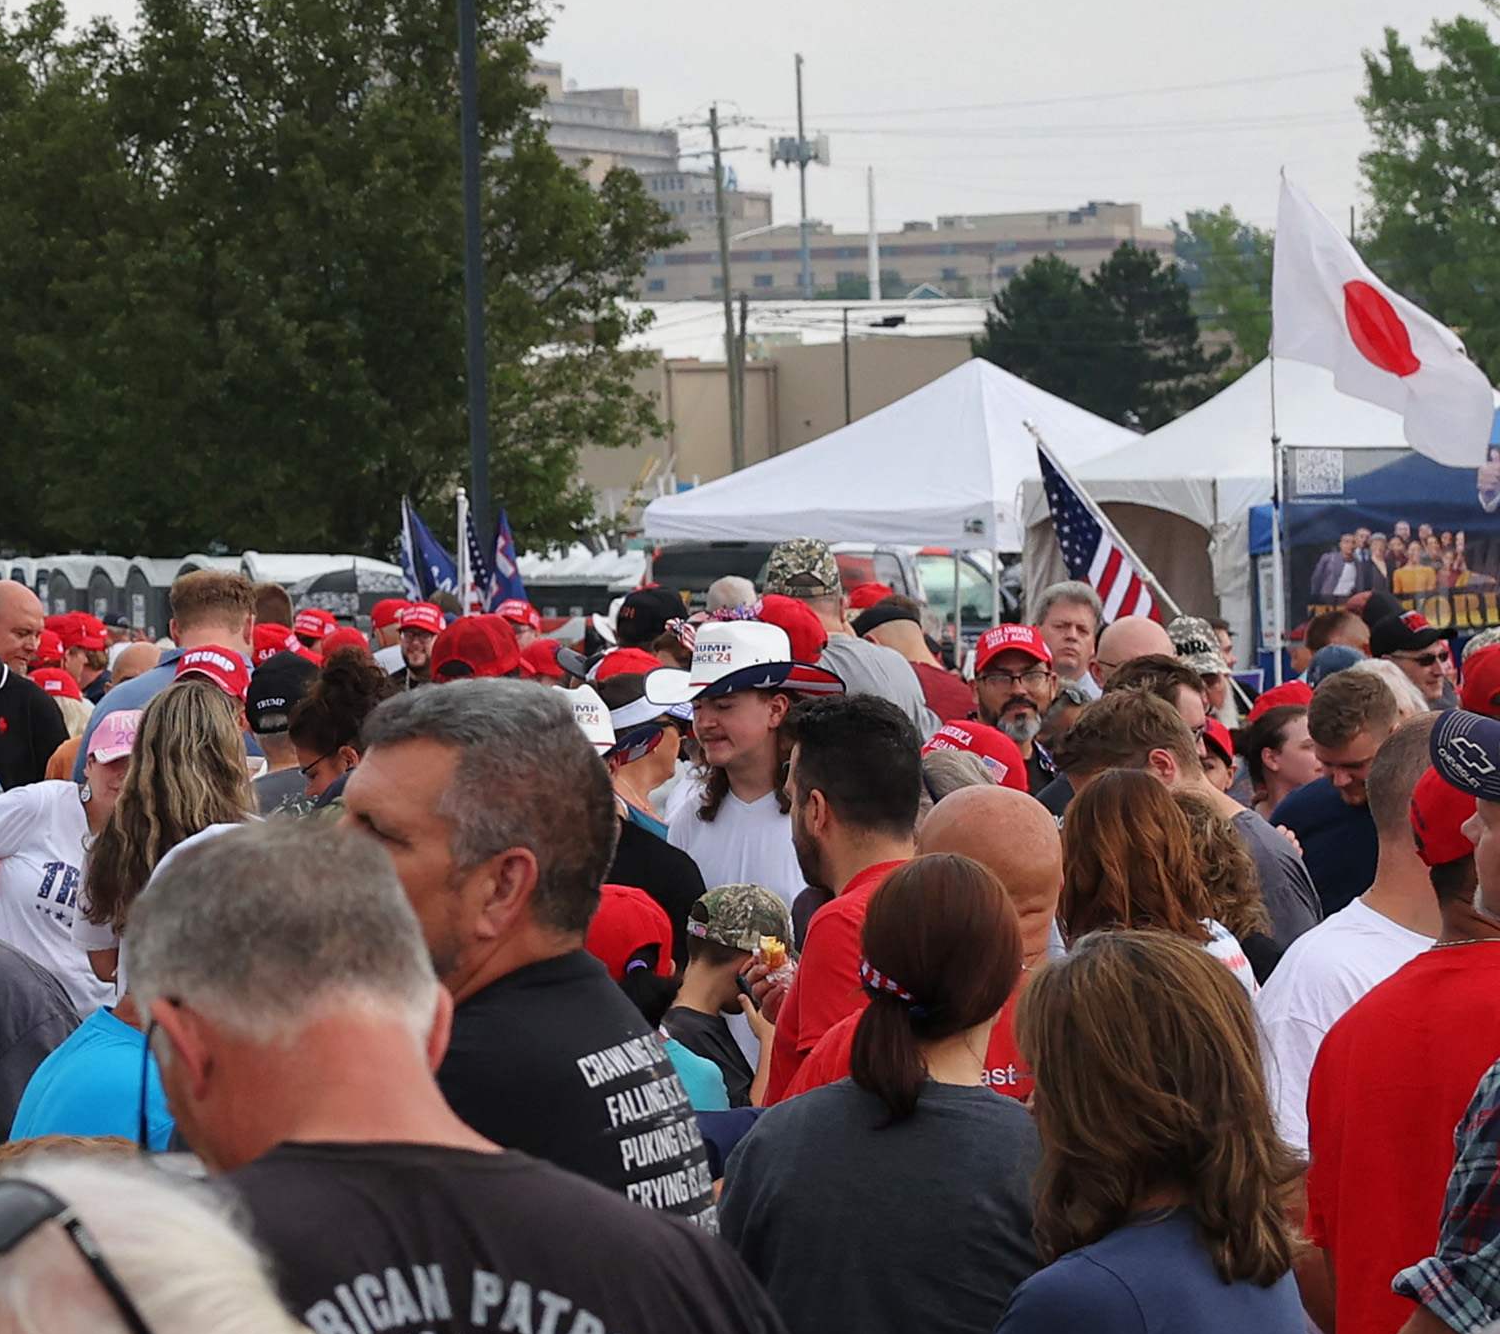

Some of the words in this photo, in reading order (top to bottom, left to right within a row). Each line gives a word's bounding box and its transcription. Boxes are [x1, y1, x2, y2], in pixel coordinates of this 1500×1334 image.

[184, 651, 236, 673] TRUMP
[1175, 640, 1213, 656] NRA
[256, 697, 286, 709] TRUMP
[1437, 747, 1482, 789] CHEVROLET
[576, 1037, 654, 1089] CRAWLING
[605, 1081, 668, 1129] FALLING
[619, 1125, 680, 1172] PUKING
[626, 1171, 690, 1211] CRYING
